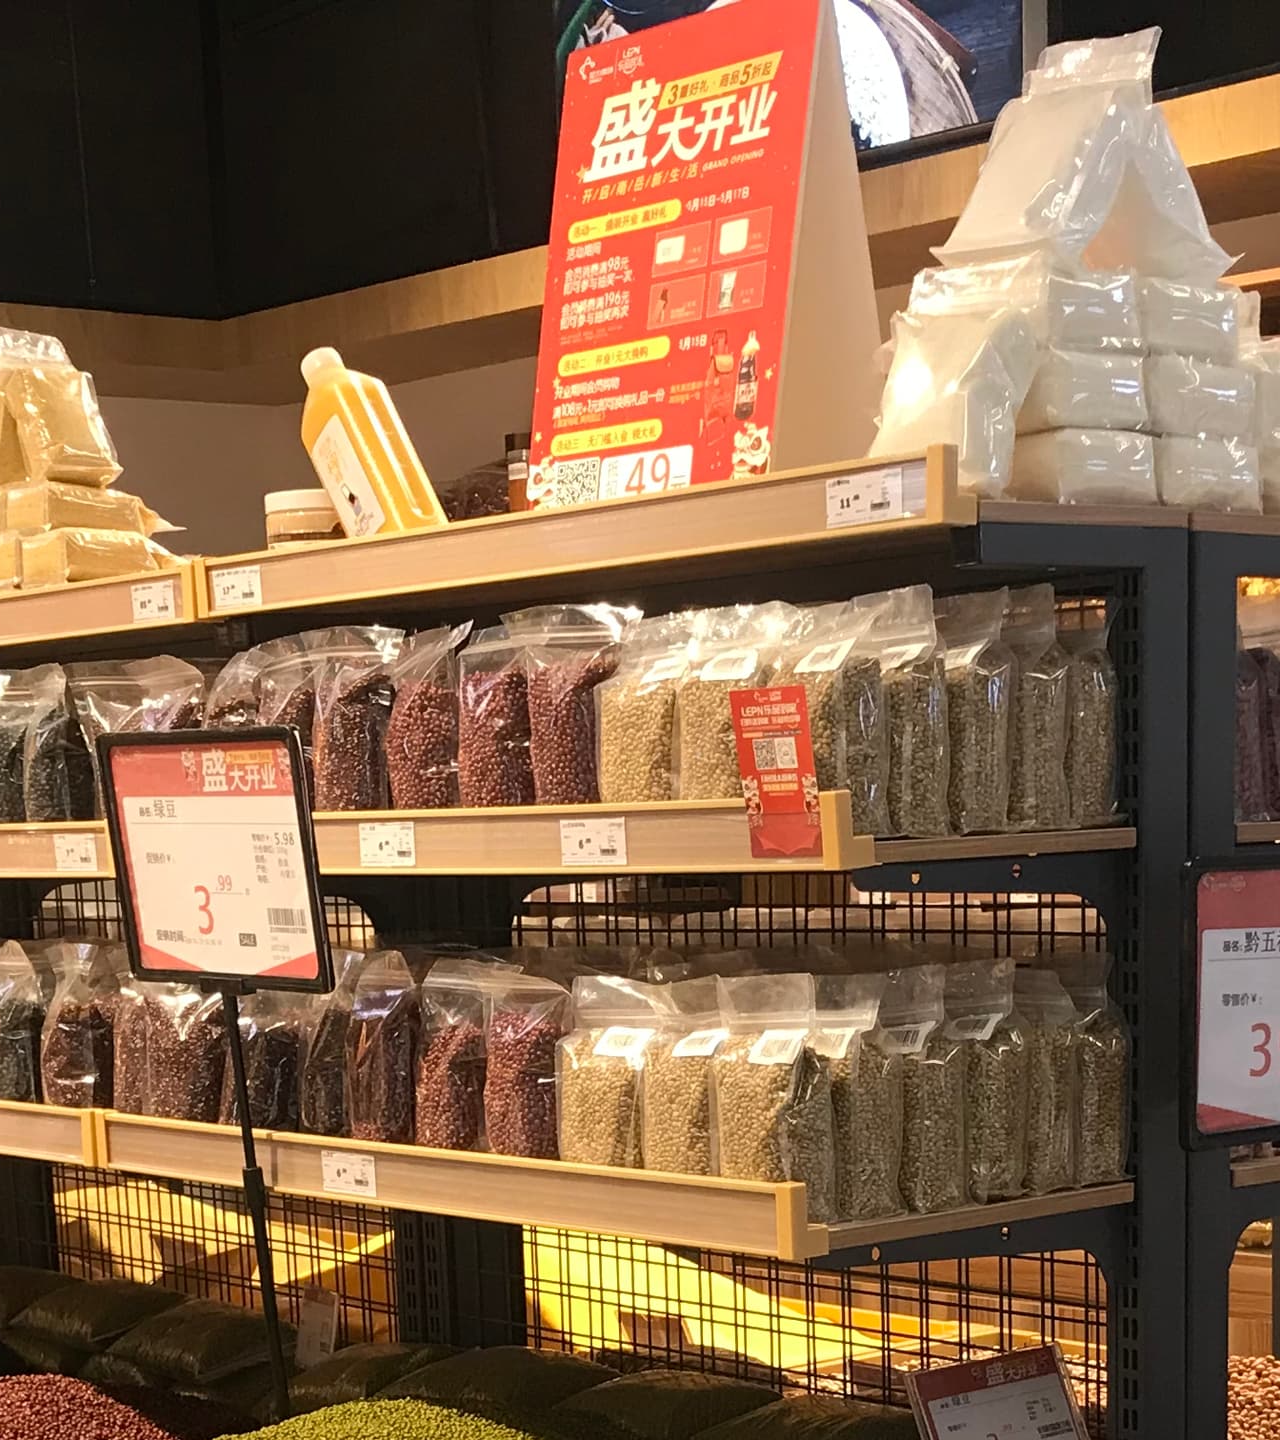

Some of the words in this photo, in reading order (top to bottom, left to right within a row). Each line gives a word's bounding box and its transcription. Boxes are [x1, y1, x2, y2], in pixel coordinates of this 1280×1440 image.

[582, 78, 778, 183] 盛大开业
[201, 750, 278, 792] 盛大开业
[274, 832, 296, 846] 5.98
[194, 885, 215, 936] 3
